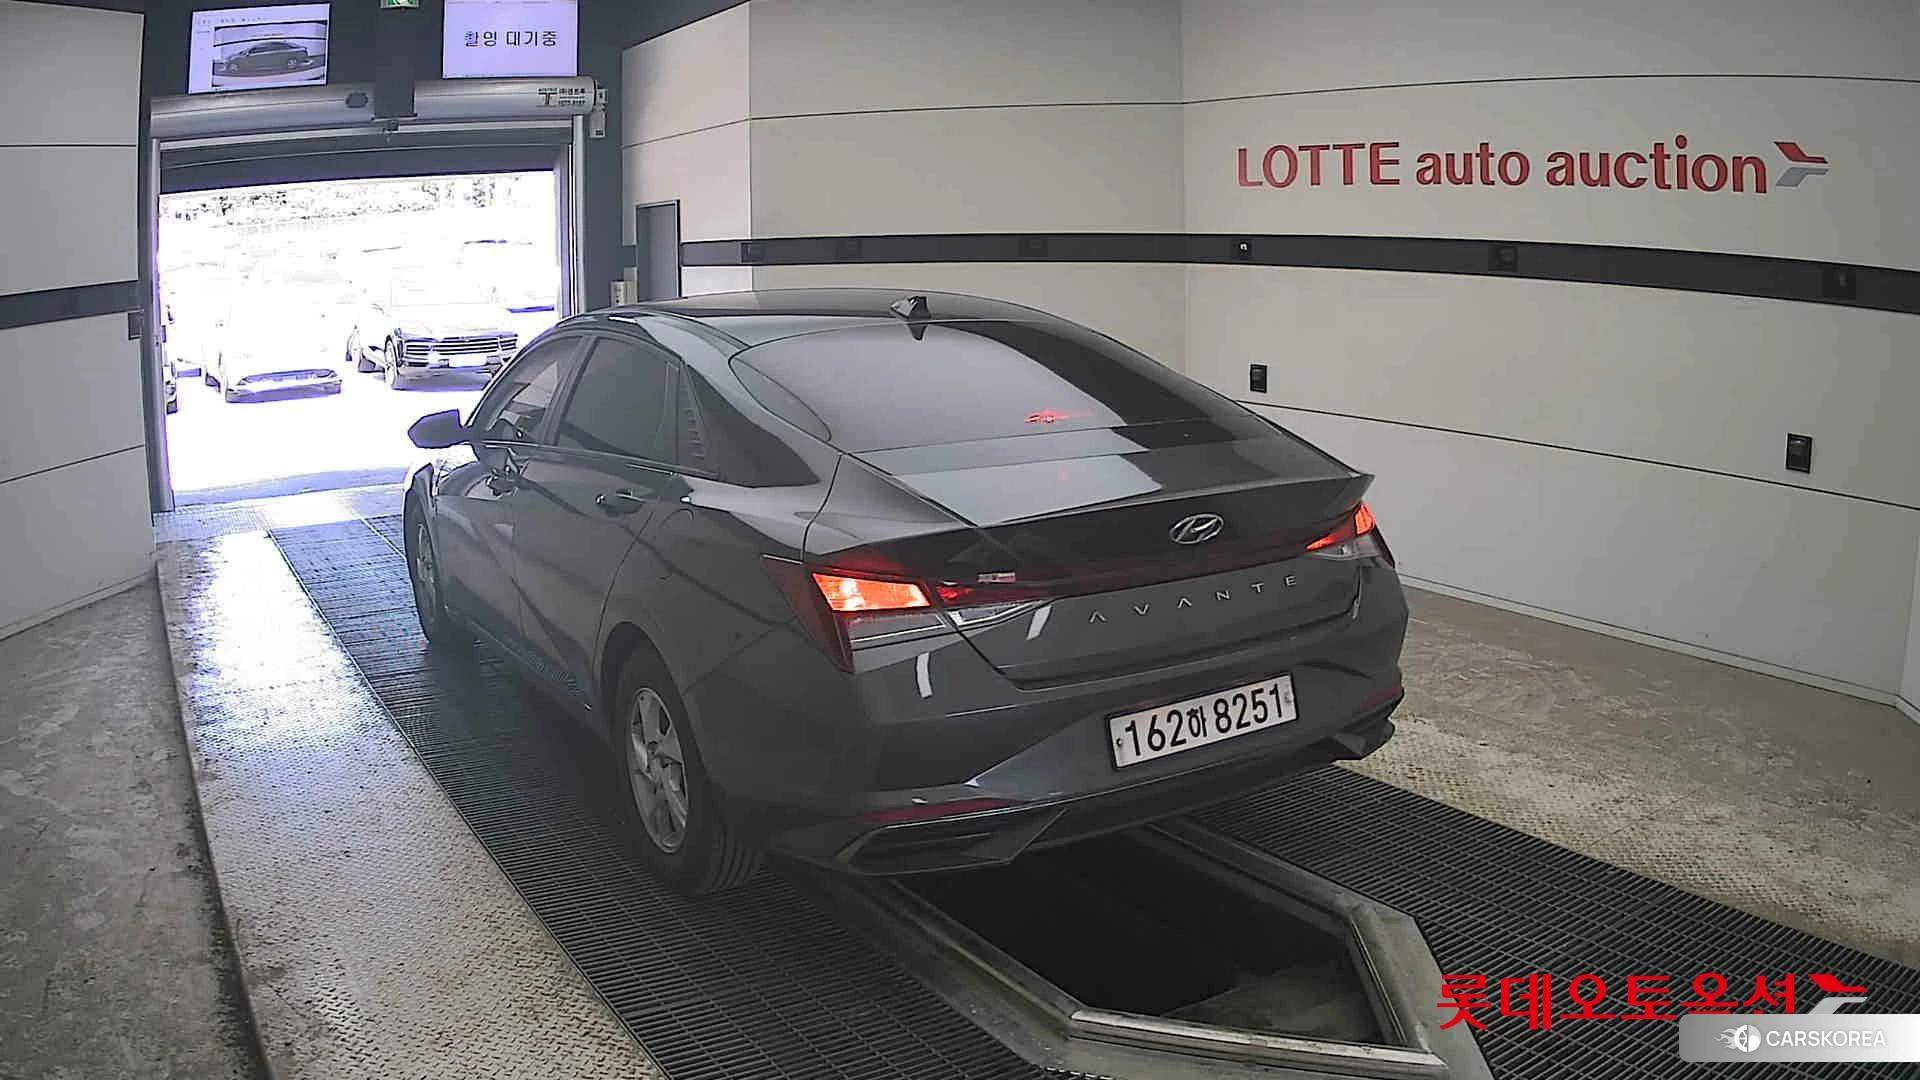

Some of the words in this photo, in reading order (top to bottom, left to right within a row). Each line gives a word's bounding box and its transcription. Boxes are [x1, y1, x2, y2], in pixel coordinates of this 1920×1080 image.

[505, 30, 557, 47] 대기중
[1236, 143, 1399, 189] LOTTE
[1416, 144, 1531, 186] auto
[1546, 136, 1767, 192] auction
[1089, 576, 1297, 624] AVANTE
